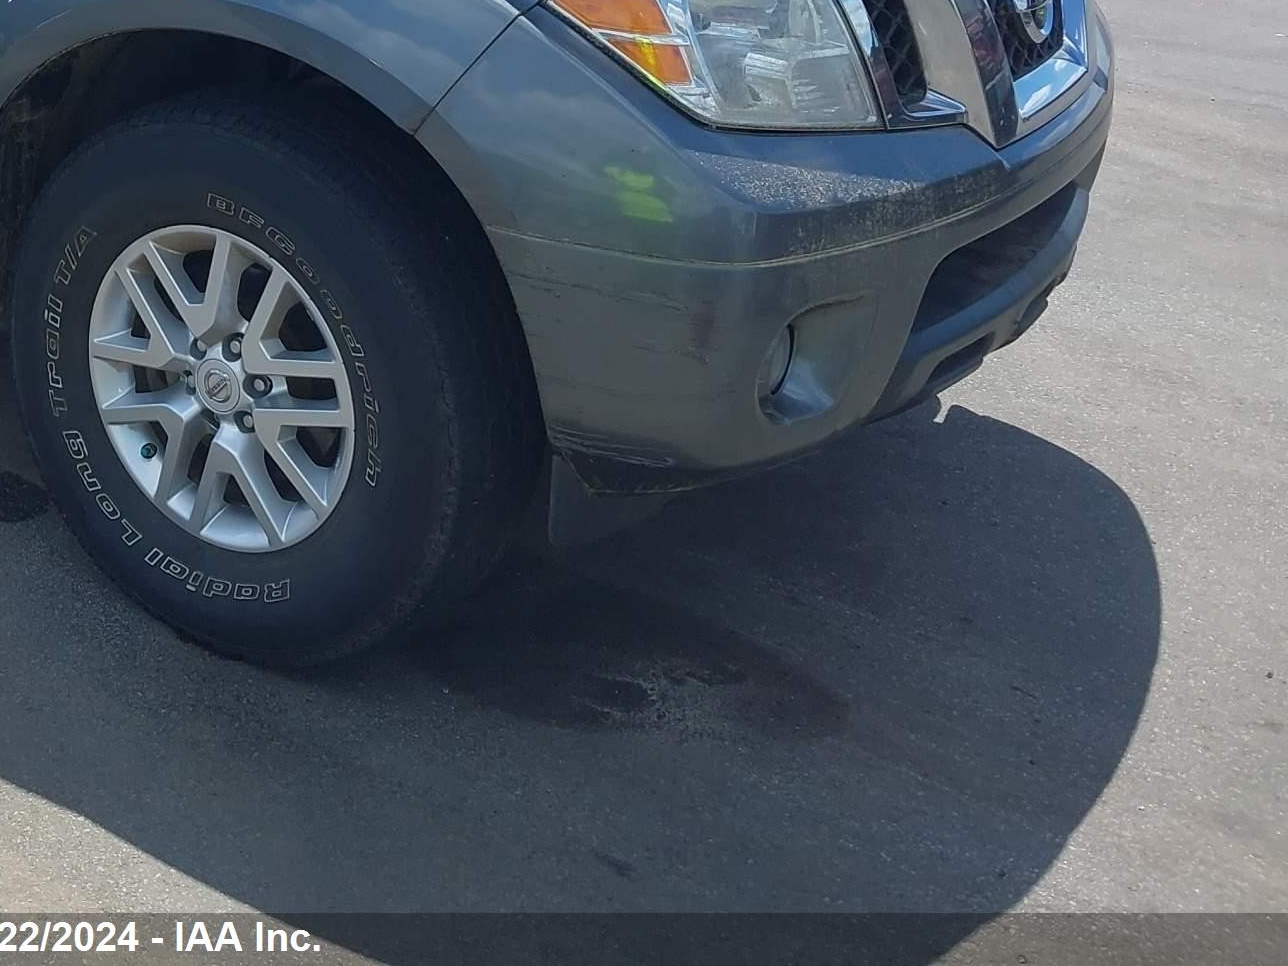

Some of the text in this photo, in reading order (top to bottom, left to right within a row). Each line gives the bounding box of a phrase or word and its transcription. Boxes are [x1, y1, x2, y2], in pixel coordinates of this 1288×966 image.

[44, 293, 69, 418] Trail
[206, 193, 381, 488] BFGoodrich
[61, 430, 142, 547] Long
[144, 547, 291, 603] Radial
